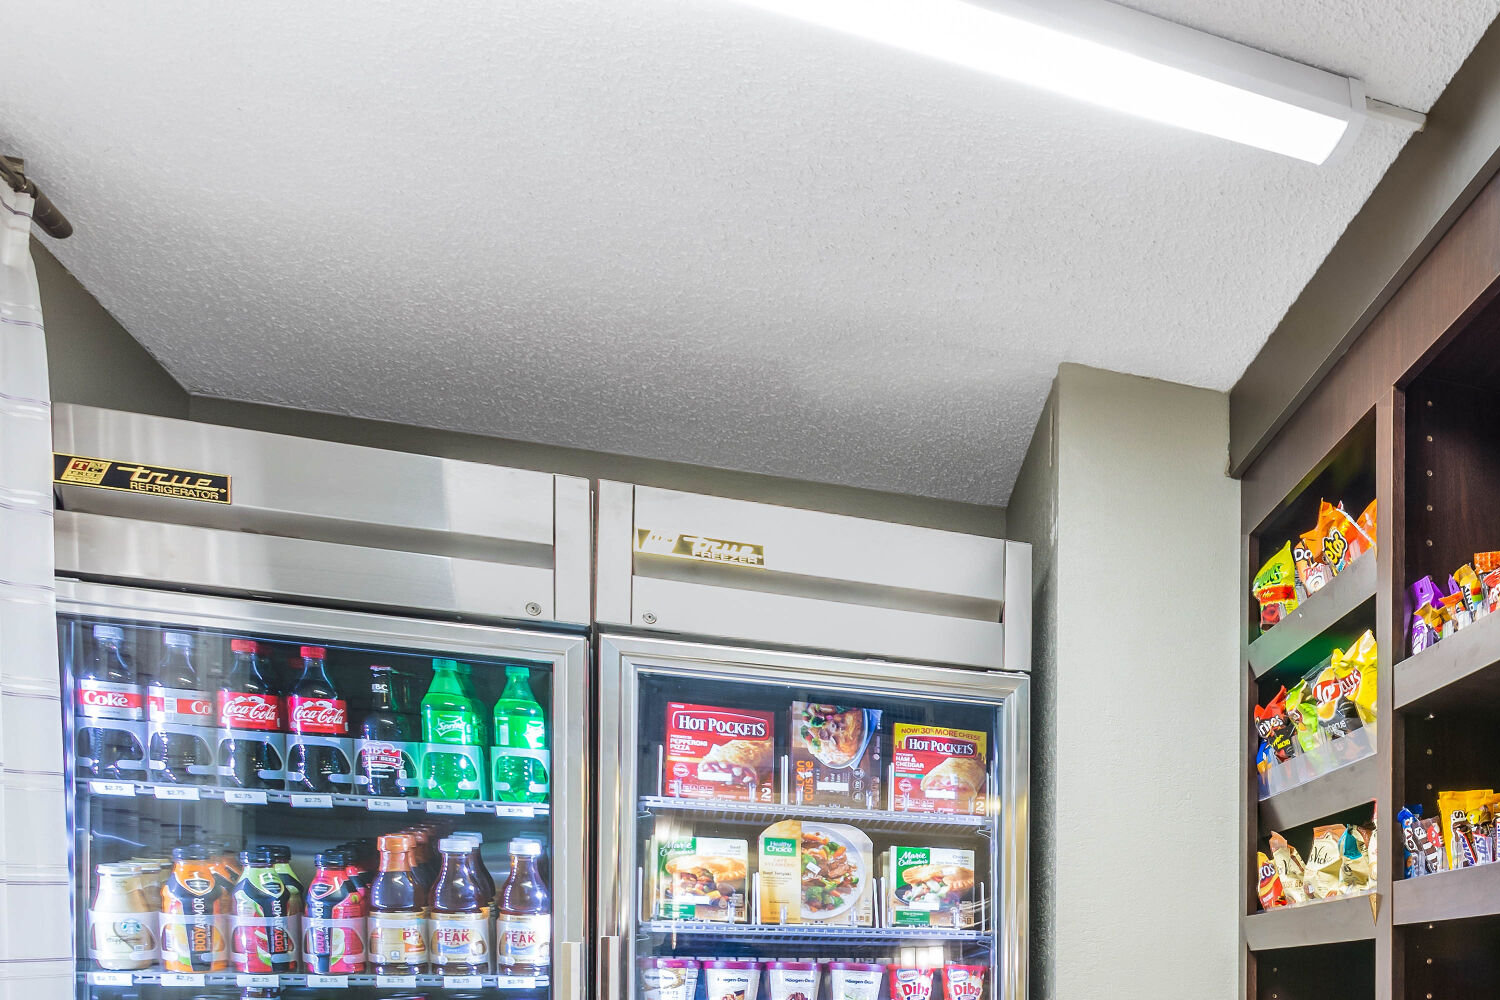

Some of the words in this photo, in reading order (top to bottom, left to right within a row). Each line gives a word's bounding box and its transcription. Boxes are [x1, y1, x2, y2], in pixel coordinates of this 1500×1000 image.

[130, 481, 219, 500] REFRIGERATOR
[691, 551, 758, 565] FREEZER
[83, 691, 128, 707] Coke
[222, 700, 277, 721] Coca-Cola
[293, 705, 344, 725] Coca-Cola
[679, 714, 706, 731] HOT
[707, 718, 766, 737] POCKETS
[935, 728, 957, 737] MORE
[670, 738, 708, 747] PEPPERONI
[909, 738, 930, 751] HOT
[931, 741, 973, 755] POCKETS
[761, 787, 771, 799] 2
[976, 801, 985, 812] 2
[766, 844, 793, 853] Choice
[769, 841, 792, 849] Healthy
[900, 851, 927, 859] Marie
[437, 931, 471, 942] PEAK
[505, 932, 536, 943] PEAK
[902, 982, 930, 997] Dibs
[953, 982, 981, 997] Dibs
